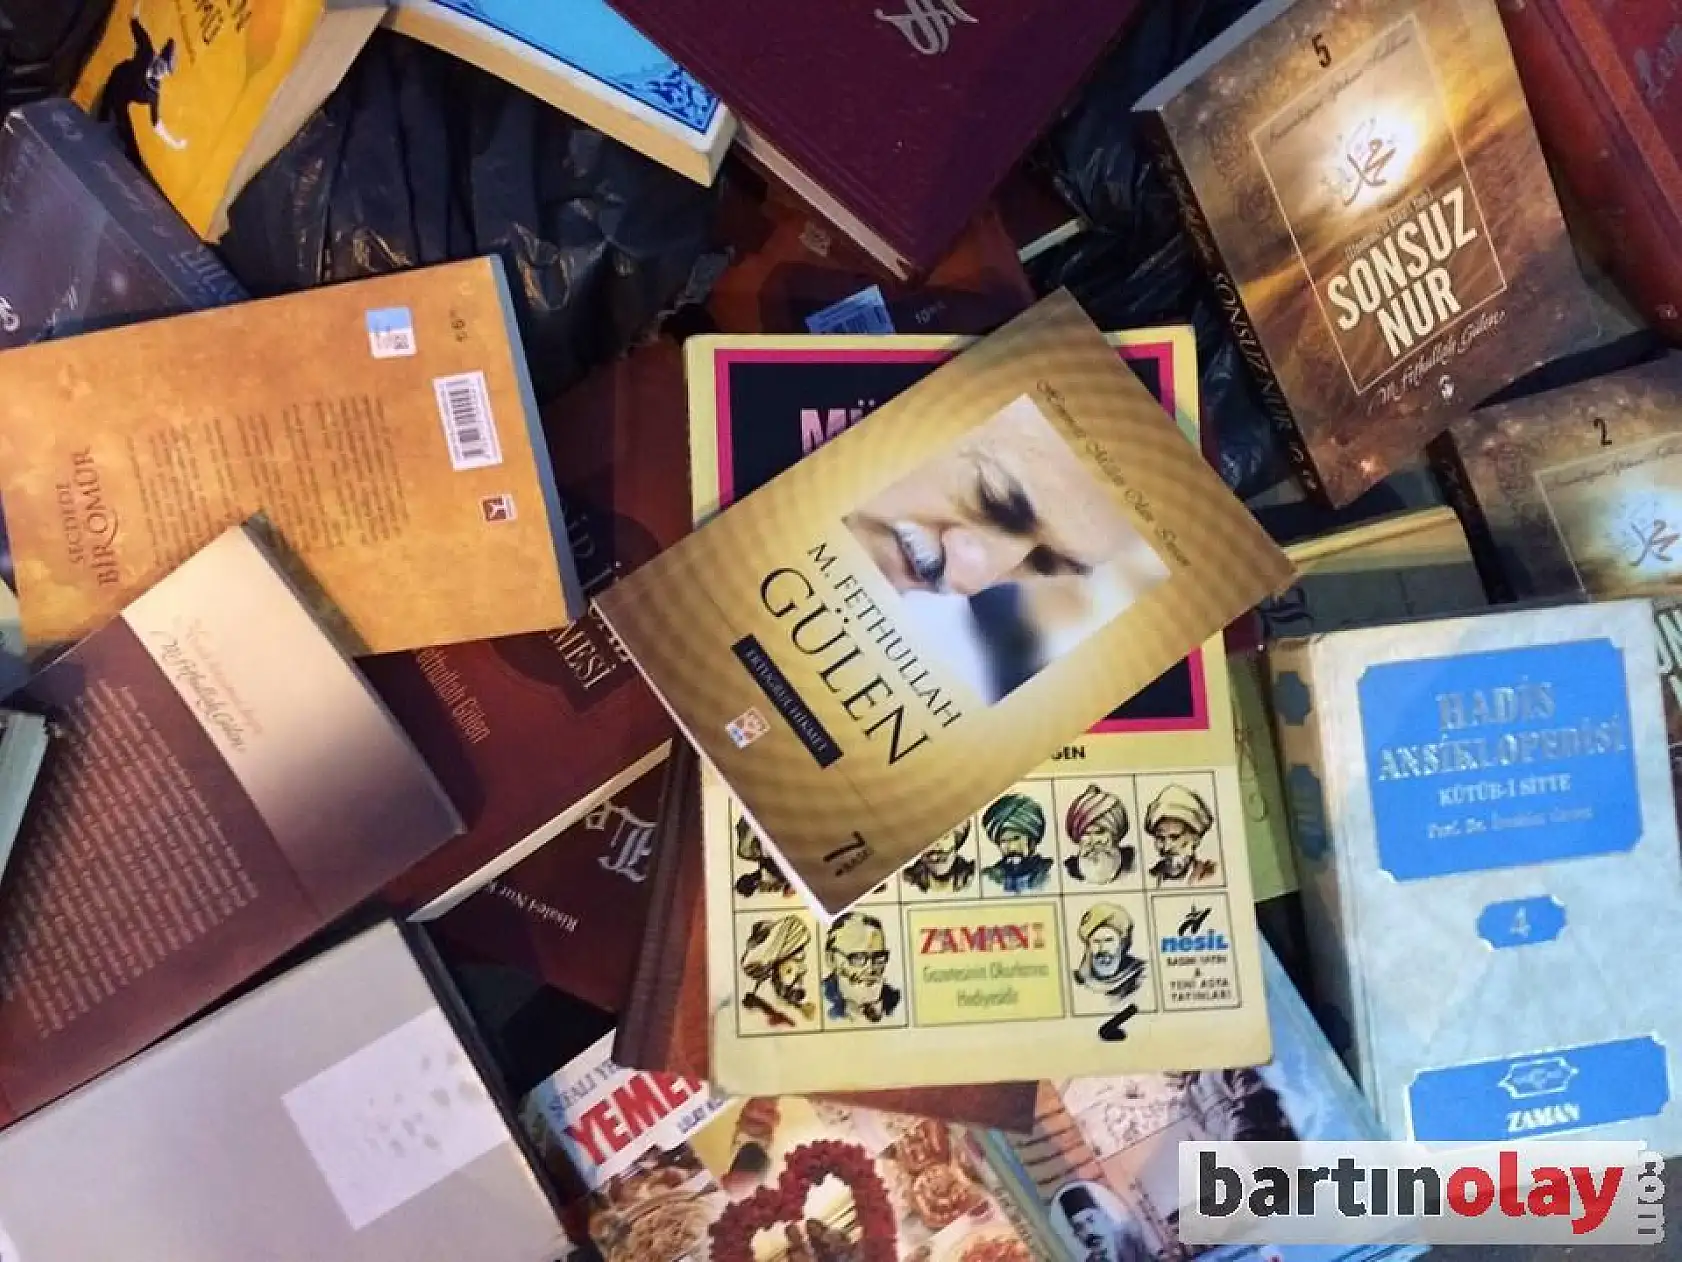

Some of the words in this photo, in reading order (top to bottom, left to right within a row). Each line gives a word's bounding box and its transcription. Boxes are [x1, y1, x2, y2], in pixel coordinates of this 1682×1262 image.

[1312, 35, 1332, 68] 5
[1326, 185, 1479, 332] SONSUZ
[1377, 268, 1461, 359] NUR
[1593, 418, 1613, 447] 2
[807, 542, 834, 579] M.
[833, 573, 963, 728] FETHULLAH
[759, 566, 930, 765] GÜLEN
[1435, 675, 1556, 729] HADİS
[1378, 713, 1628, 782] ANSİKLOPEDİSİ
[920, 924, 1029, 955] ZAMAN
[1509, 907, 1532, 938] 4
[1506, 1103, 1581, 1133] ZAMAN
